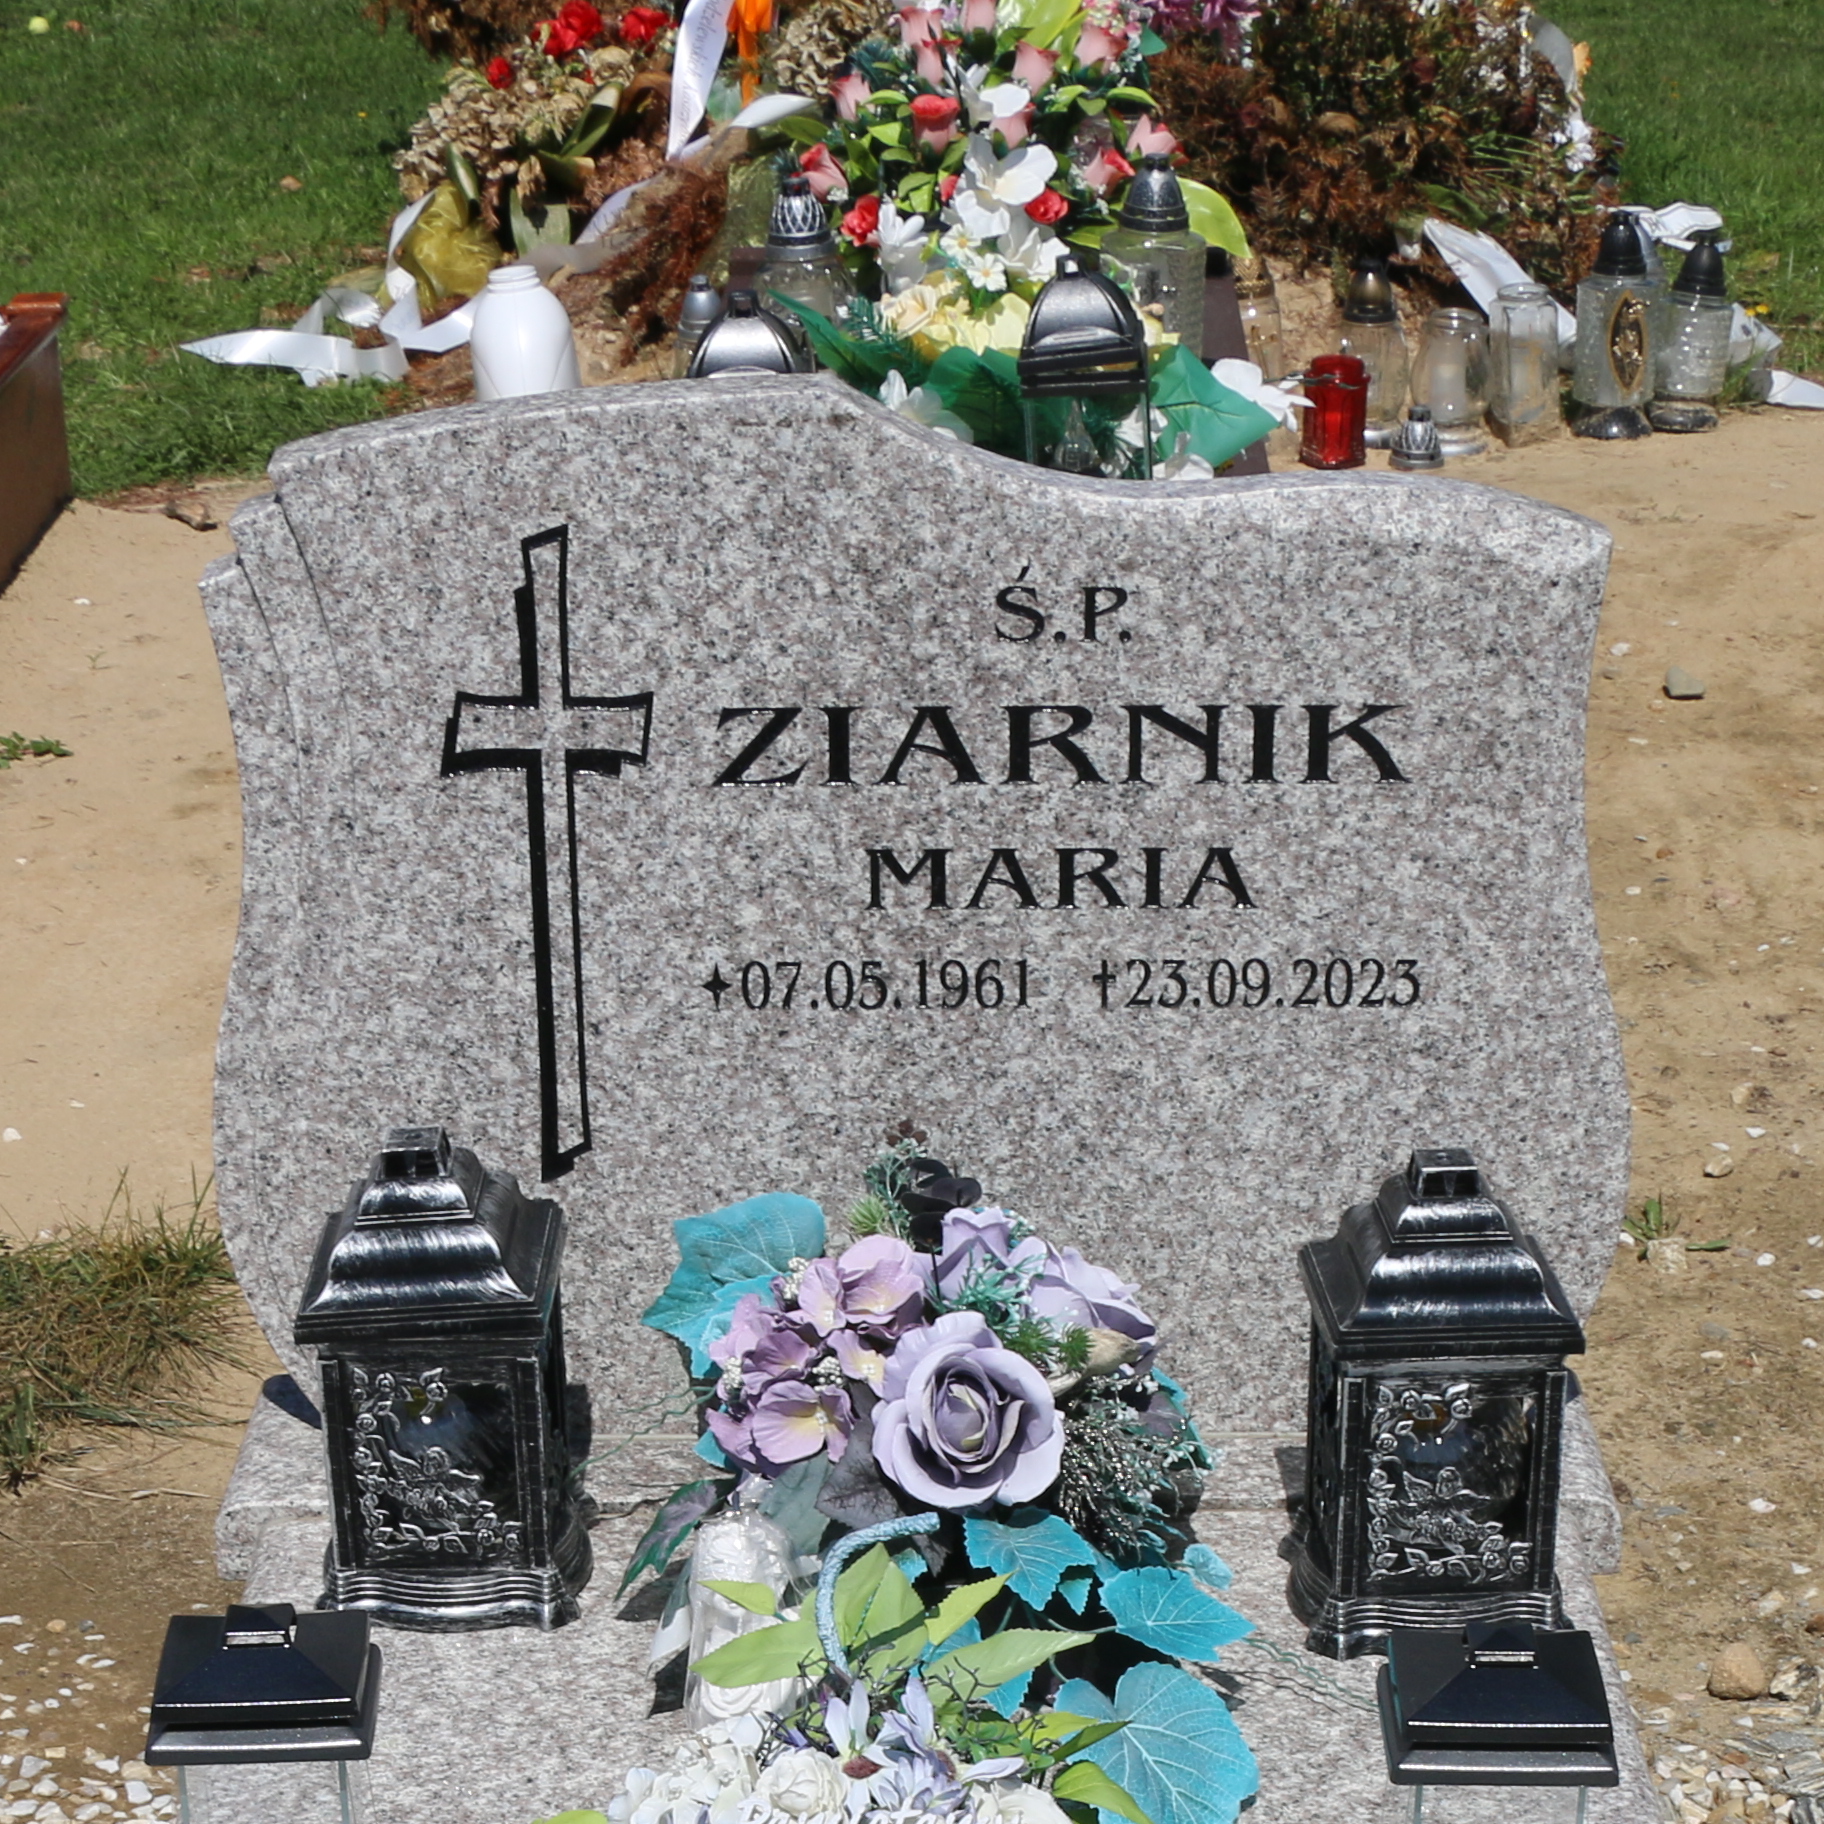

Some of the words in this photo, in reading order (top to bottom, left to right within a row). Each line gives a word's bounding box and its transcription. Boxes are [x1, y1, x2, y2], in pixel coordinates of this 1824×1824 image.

[993, 564, 1134, 644] Ś.P.
[710, 703, 1412, 788] ZIARNIK
[863, 846, 1259, 911] MARIA
